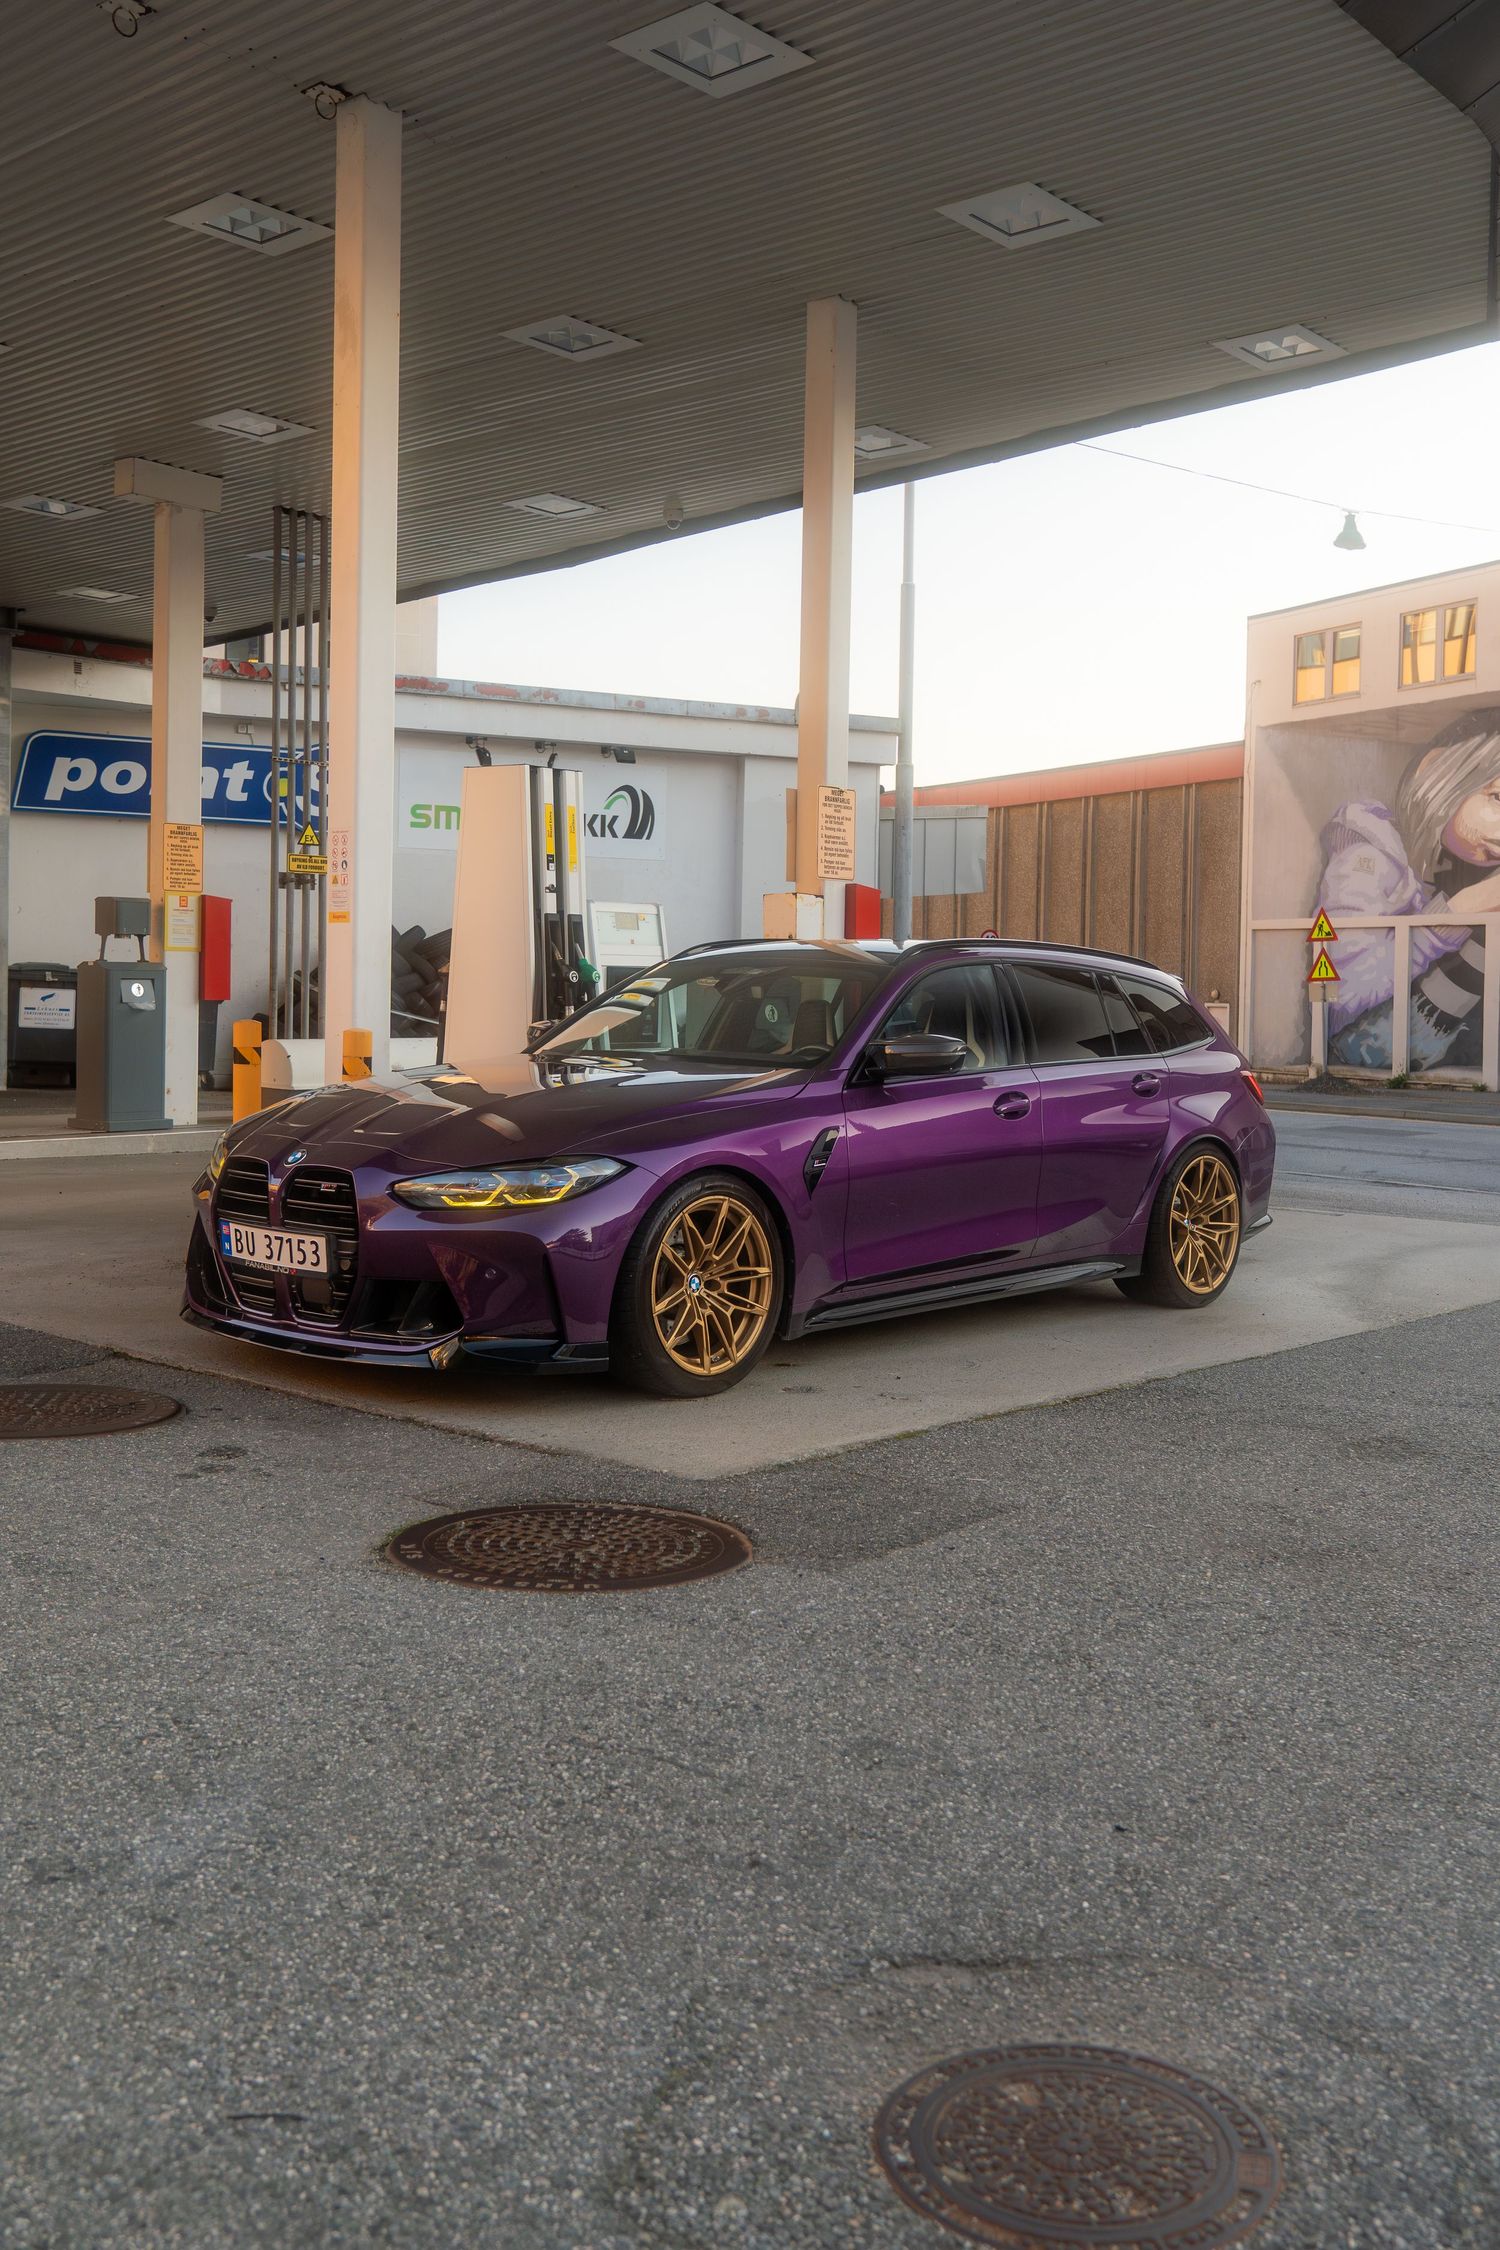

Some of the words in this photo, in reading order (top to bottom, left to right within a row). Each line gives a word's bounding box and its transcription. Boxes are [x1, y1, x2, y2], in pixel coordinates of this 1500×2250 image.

[44, 756, 254, 801] pot
[305, 835, 314, 843] EX
[225, 1242, 230, 1250] N
[234, 1228, 256, 1257] BU
[264, 1234, 321, 1267] 37153
